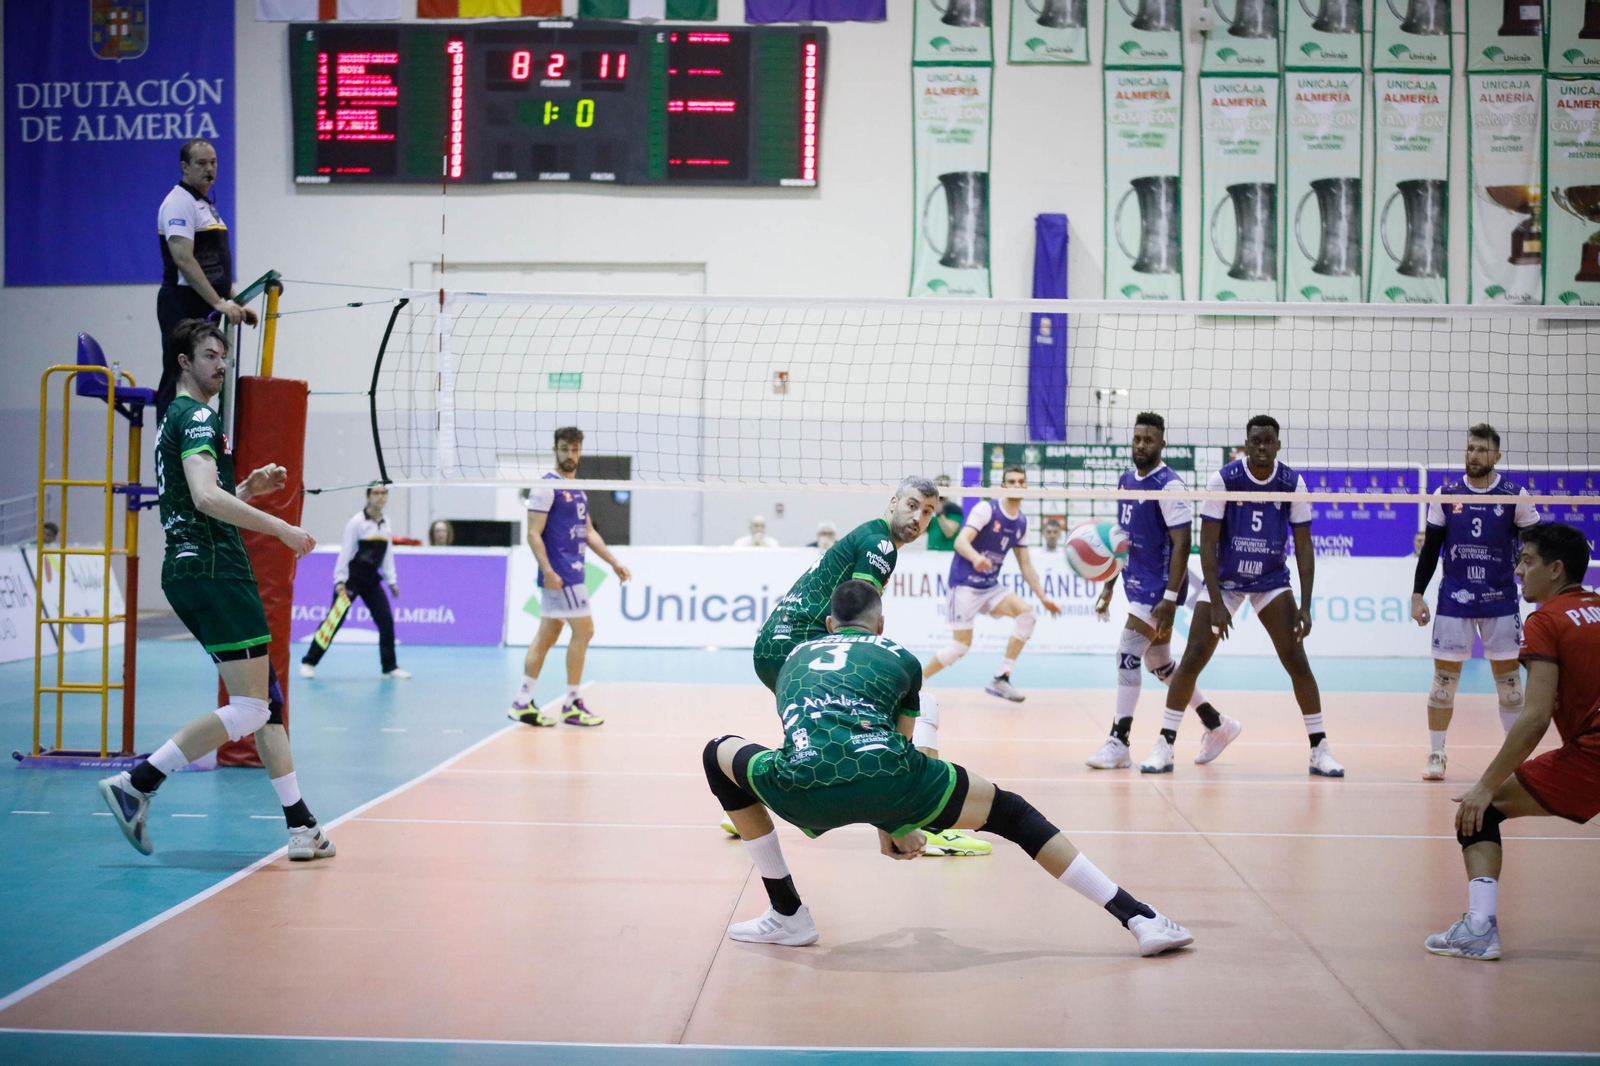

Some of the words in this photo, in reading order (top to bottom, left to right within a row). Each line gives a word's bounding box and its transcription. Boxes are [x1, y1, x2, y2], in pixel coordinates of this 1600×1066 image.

[511, 50, 531, 80] 8
[547, 52, 566, 78] 2
[1503, 53, 1531, 62] Unicaja
[16, 72, 224, 109] DIPUTACIÓN
[1118, 78, 1168, 87] UNICAJA
[1214, 85, 1264, 94] UNICAJA
[1298, 79, 1348, 89] UNICAJA
[1387, 79, 1437, 90] UNICAJA
[1482, 80, 1530, 90] UNICAJA
[576, 99, 594, 127] 0
[20, 115, 63, 143] DE
[70, 106, 220, 141] ALMERÍA
[1554, 140, 1583, 149] Superliga
[1121, 503, 1133, 525] 15
[1251, 510, 1263, 532] 5
[1471, 517, 1482, 538] 3
[1234, 540, 1266, 548] COMUNITAT
[893, 573, 932, 598] HLA
[620, 584, 785, 624] Unicaj
[1514, 613, 1521, 630] 3
[808, 642, 853, 671] 3
